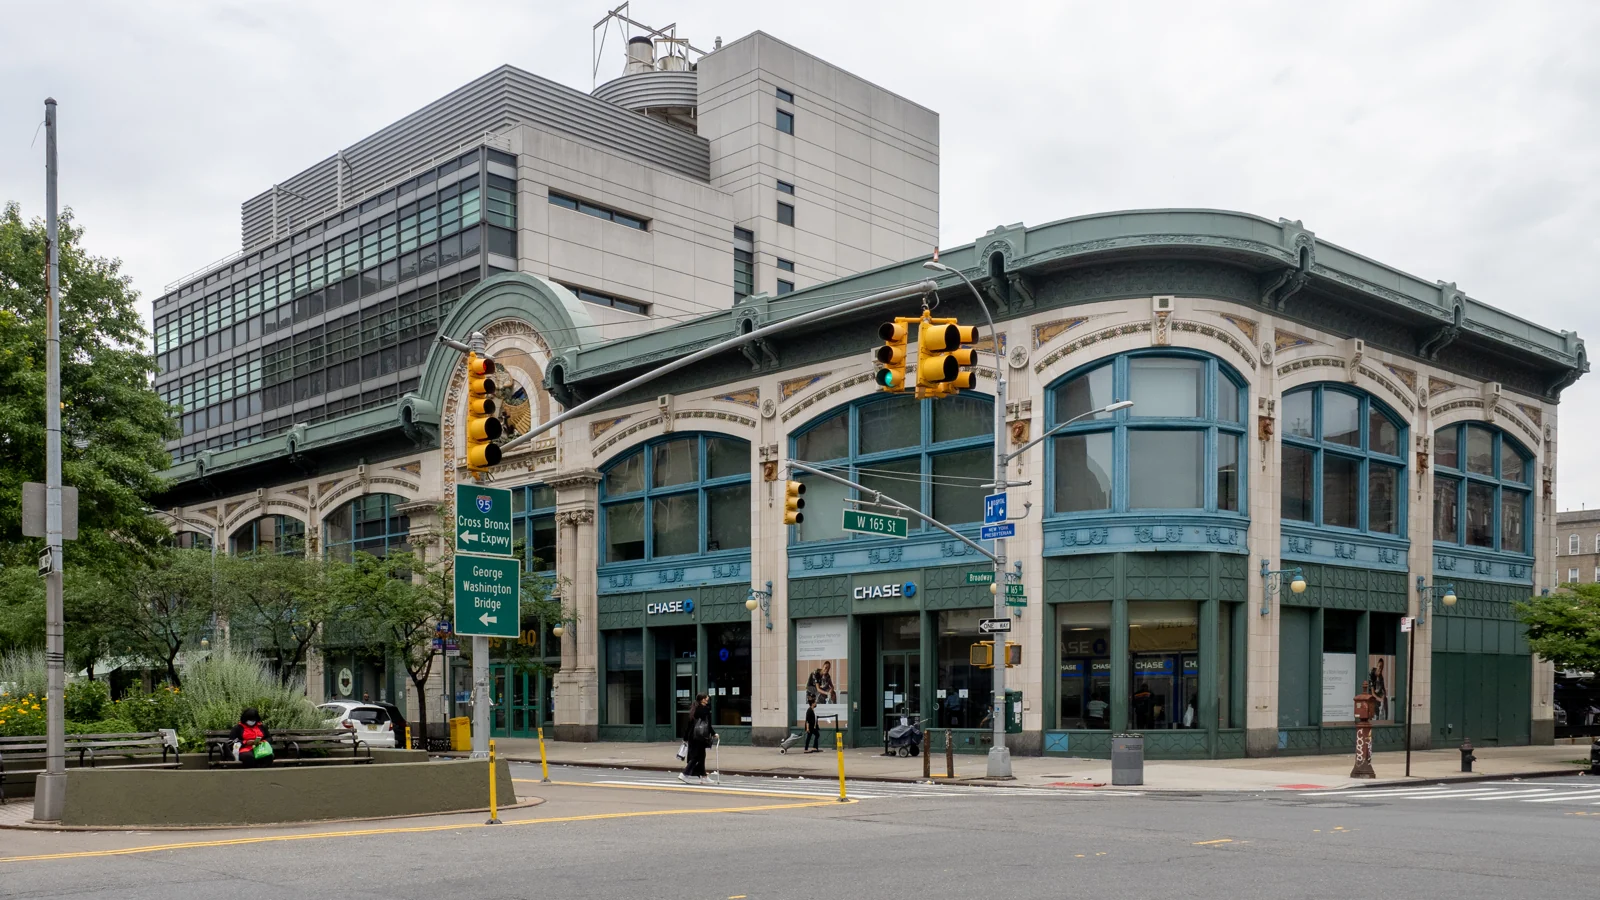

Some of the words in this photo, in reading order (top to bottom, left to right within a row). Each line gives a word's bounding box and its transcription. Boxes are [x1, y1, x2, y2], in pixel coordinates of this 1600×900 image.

[478, 499, 490, 510] 95
[458, 515, 481, 528] Cross
[484, 518, 510, 530] Bronx
[857, 516, 866, 528] W
[870, 518, 884, 531] 165
[887, 520, 896, 532] St
[481, 532, 510, 547] Expwy
[473, 565, 503, 581] George
[970, 574, 992, 582] Broadway
[463, 580, 512, 596] Washington
[854, 584, 901, 599] CHASE
[474, 597, 502, 612] Bridge
[647, 600, 683, 614] CHASE
